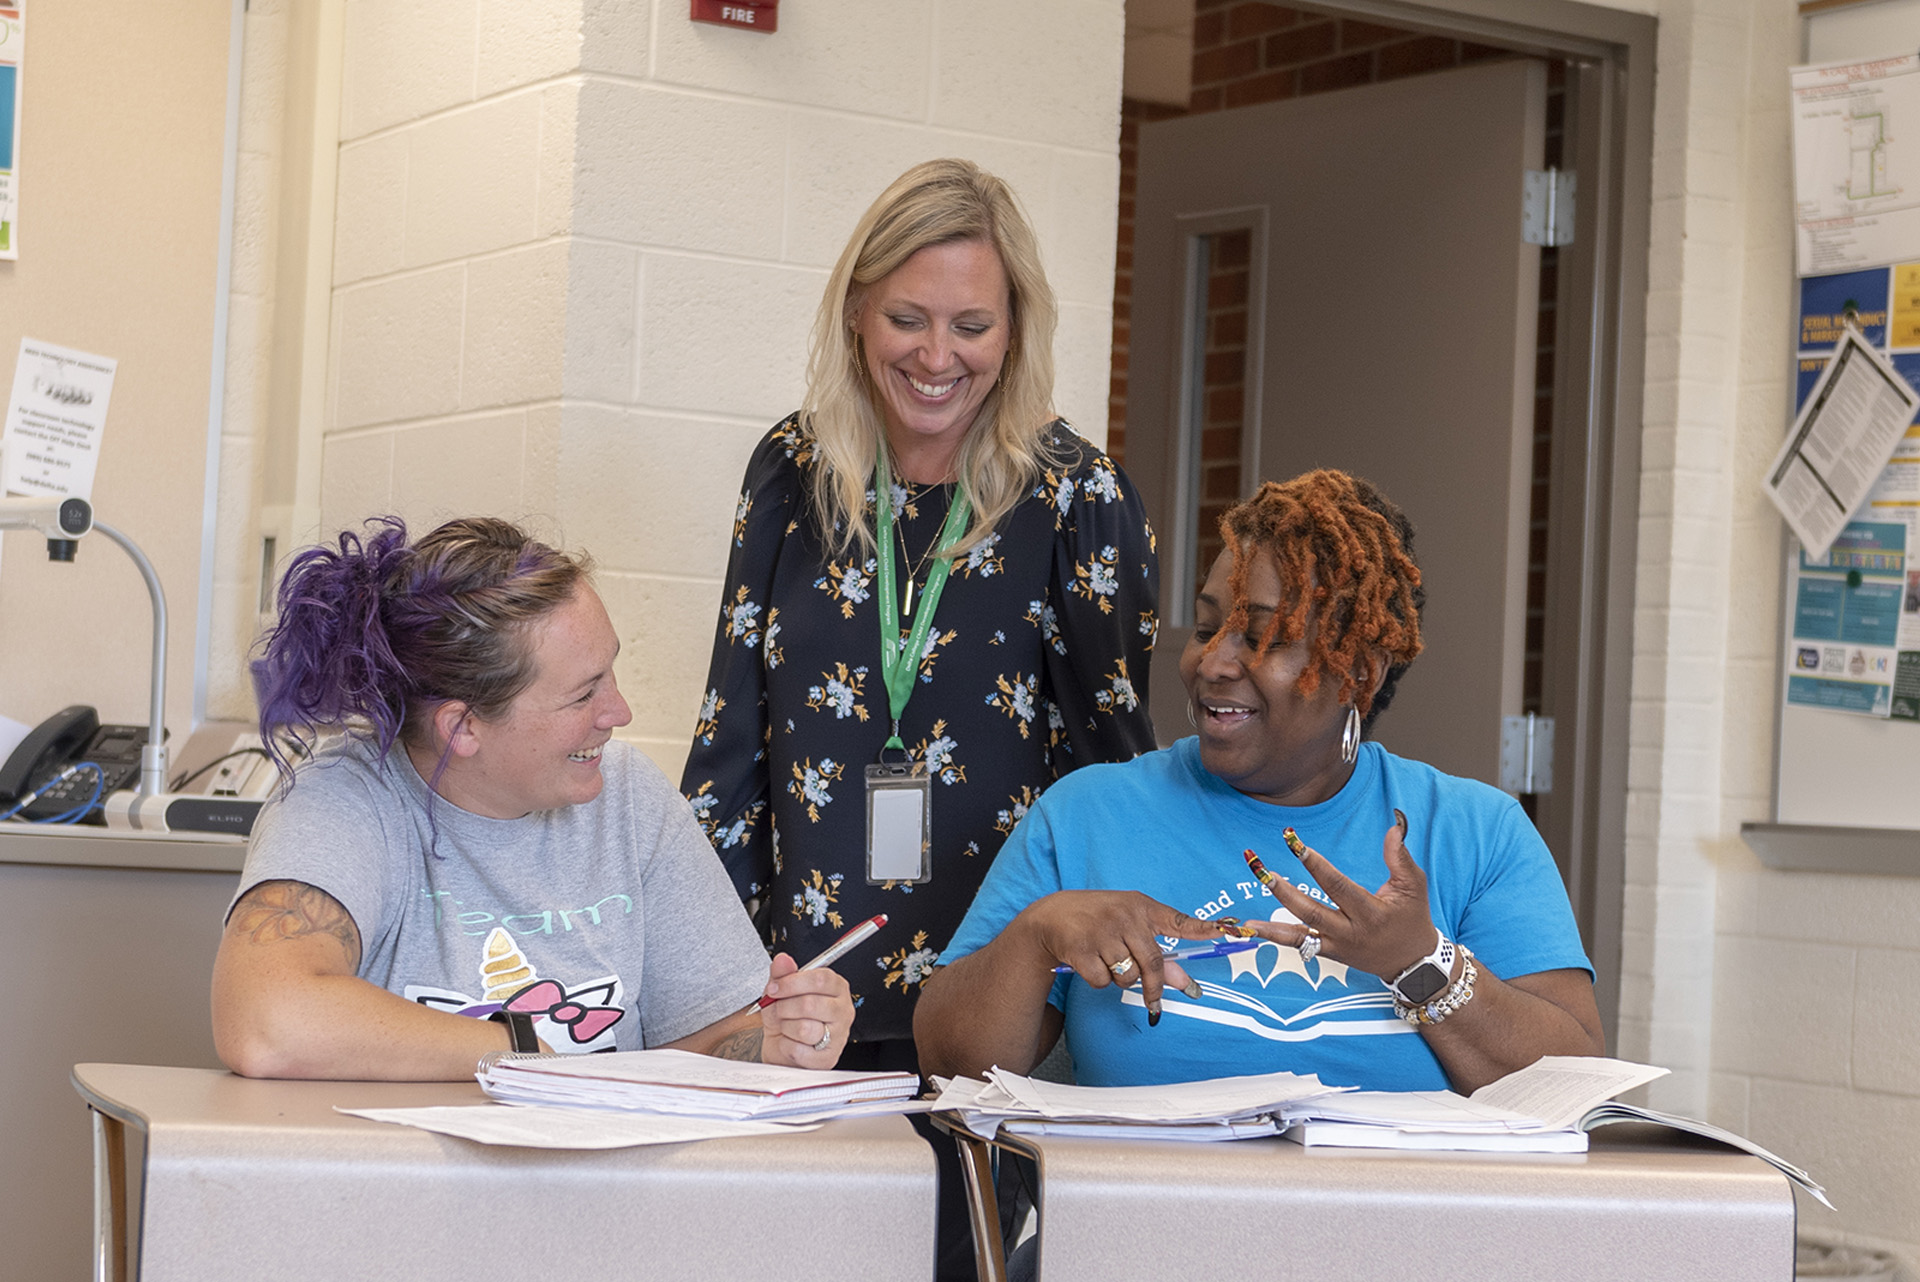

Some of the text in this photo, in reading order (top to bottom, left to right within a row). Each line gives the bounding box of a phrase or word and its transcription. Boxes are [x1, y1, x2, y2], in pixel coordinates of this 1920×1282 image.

[722, 6, 755, 24] FIRE
[1803, 315, 1832, 330] SEXUAL
[904, 573, 942, 671] Delta College Child Development Program
[1194, 889, 1235, 921] and
[1236, 881, 1273, 900] T's
